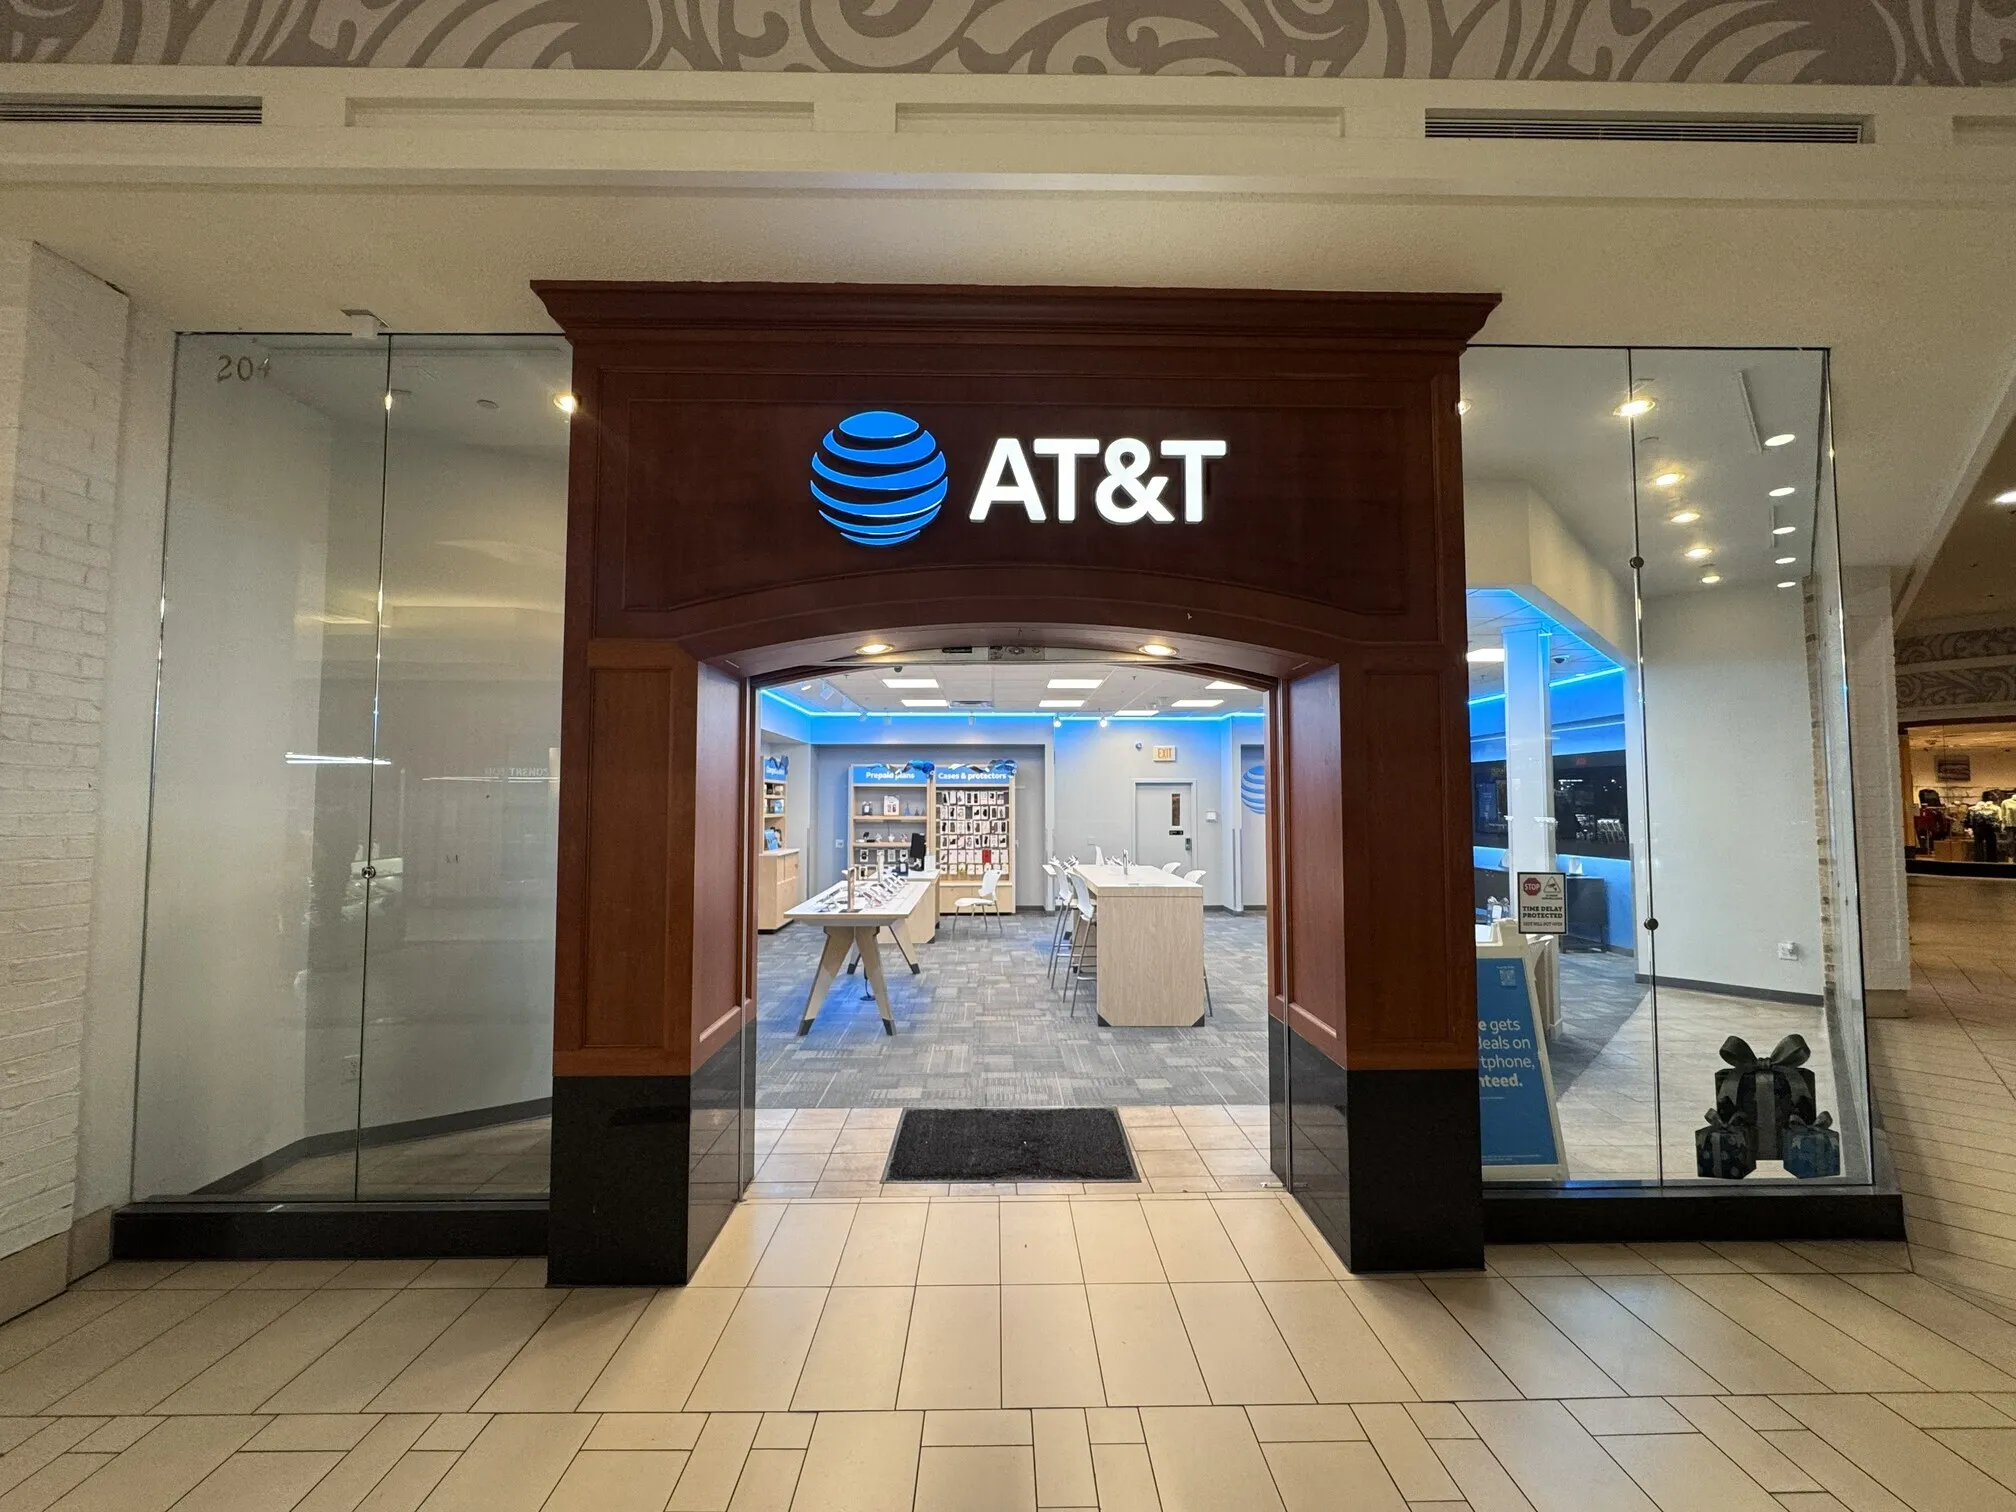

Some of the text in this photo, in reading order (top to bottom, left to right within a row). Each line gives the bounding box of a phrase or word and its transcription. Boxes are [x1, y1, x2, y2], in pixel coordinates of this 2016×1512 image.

[968, 436, 1227, 525] AT&T
[1157, 747, 1172, 760] EXIT
[865, 771, 894, 781] Prepaid
[937, 772, 1007, 782] Cases & protectors
[1524, 883, 1540, 891] STOP
[1490, 1018, 1521, 1034] gets
[1512, 1038, 1531, 1049] on
